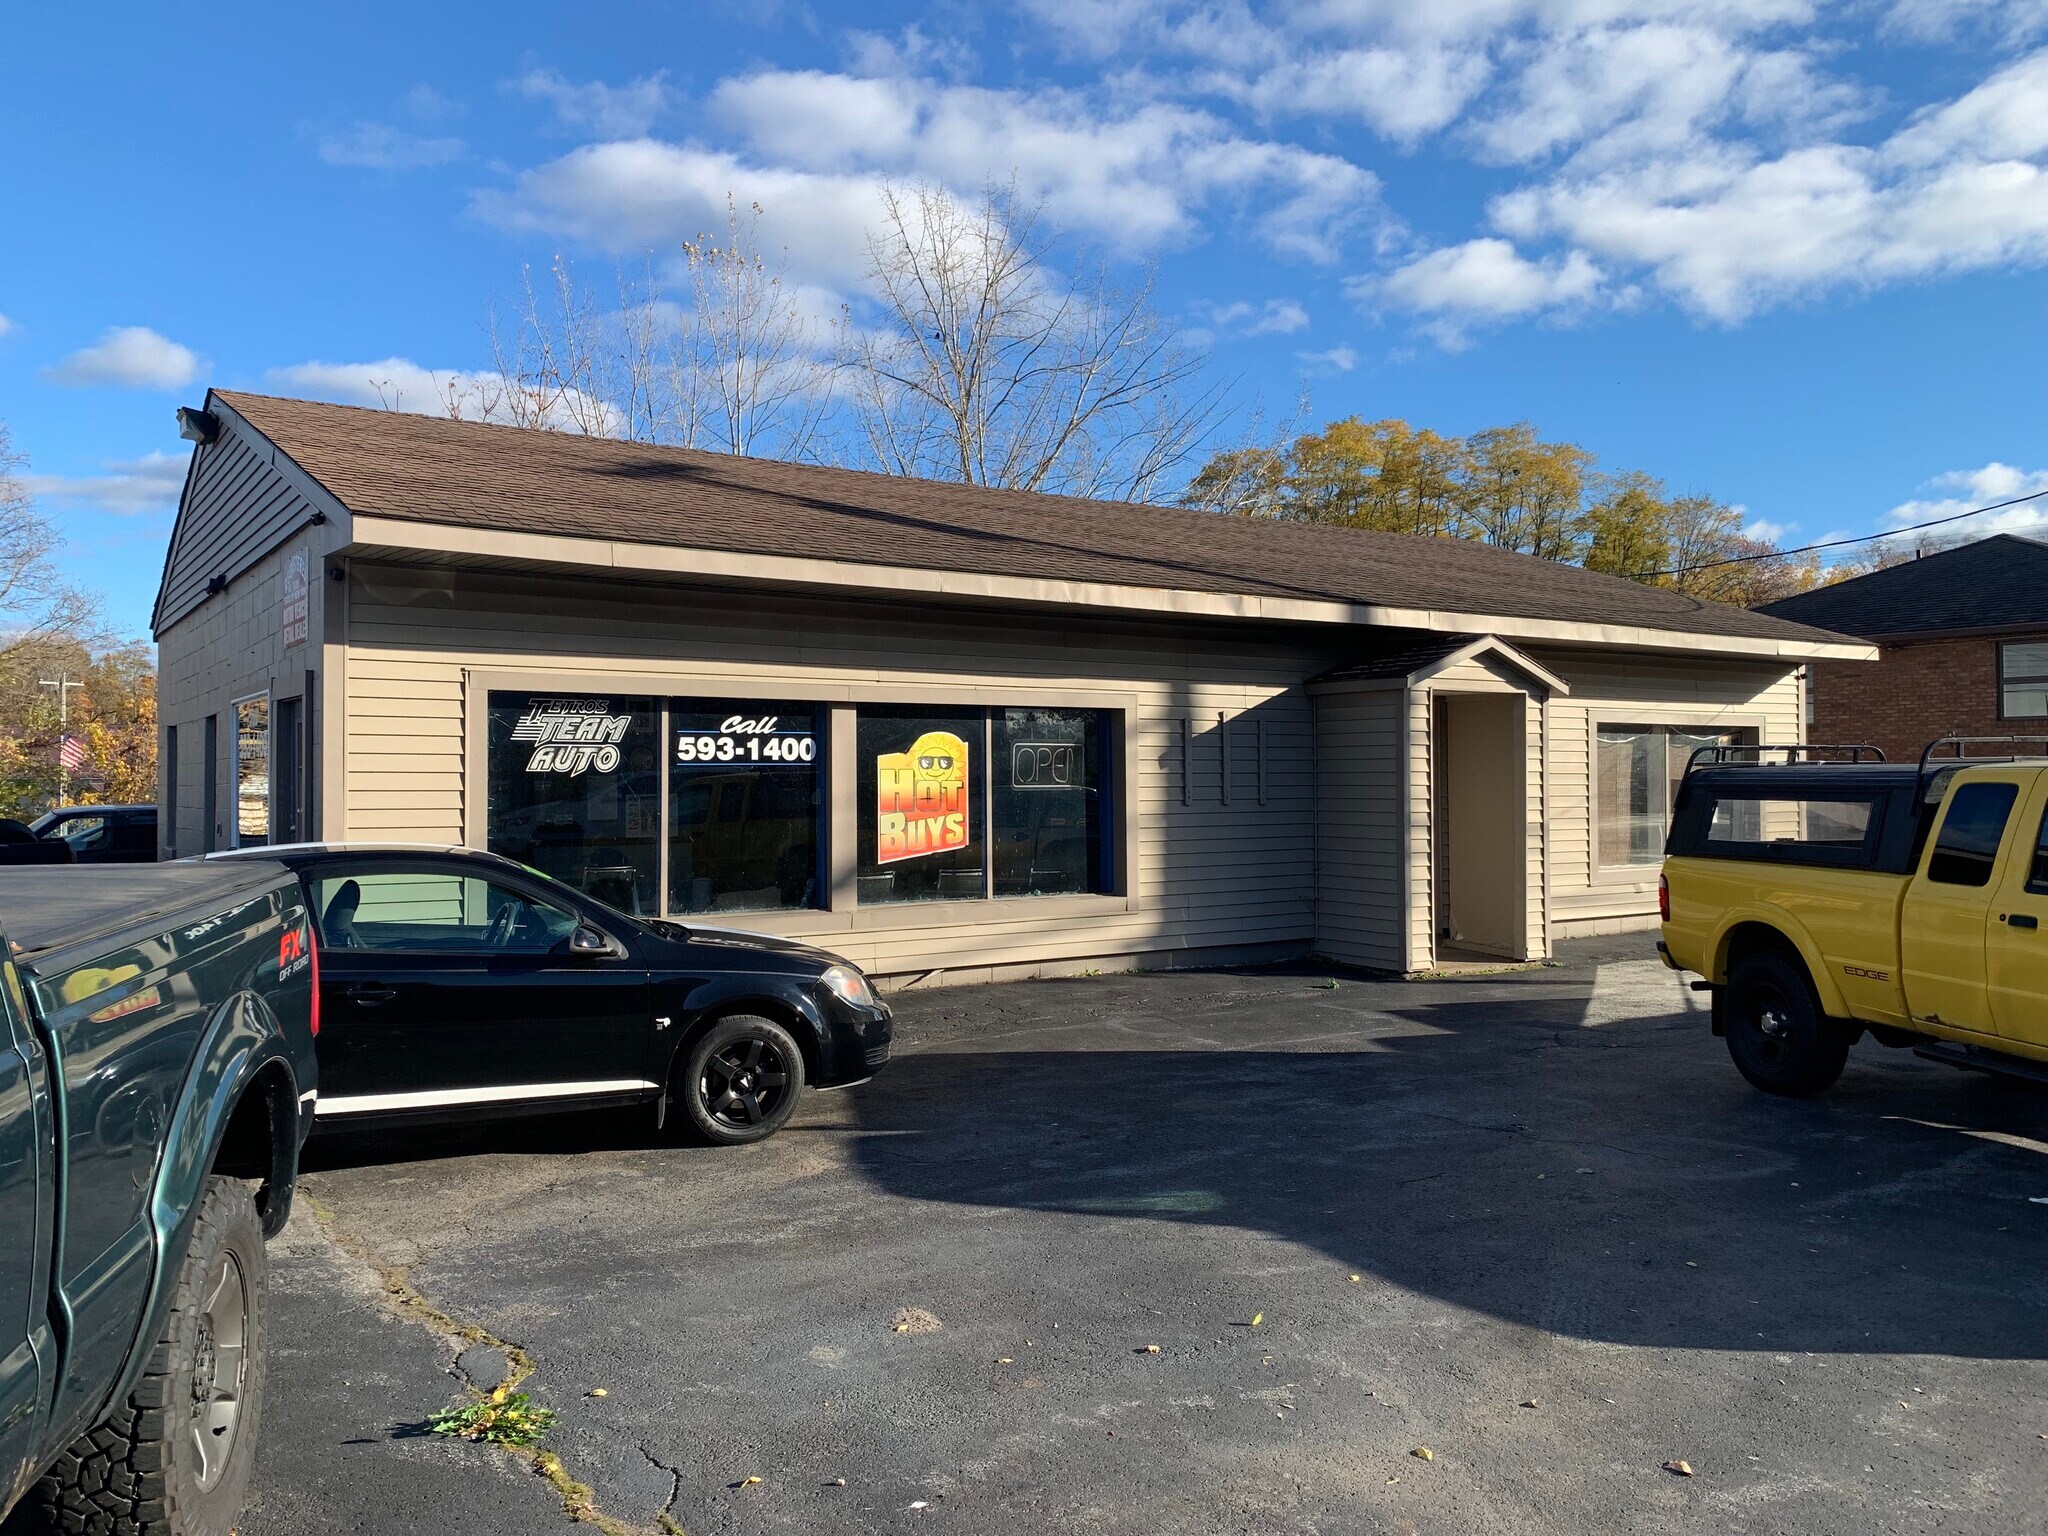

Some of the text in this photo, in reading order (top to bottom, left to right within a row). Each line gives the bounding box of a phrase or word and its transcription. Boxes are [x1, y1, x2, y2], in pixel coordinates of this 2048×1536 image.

[534, 714, 632, 748] TEAM
[720, 715, 778, 734] Call
[525, 744, 621, 778] AUTO
[677, 736, 817, 761] 593-1400
[880, 768, 964, 812] HOT
[880, 811, 965, 854] BUYS
[279, 954, 309, 982] OFF ROAD
[1843, 965, 1890, 982] EDGE
